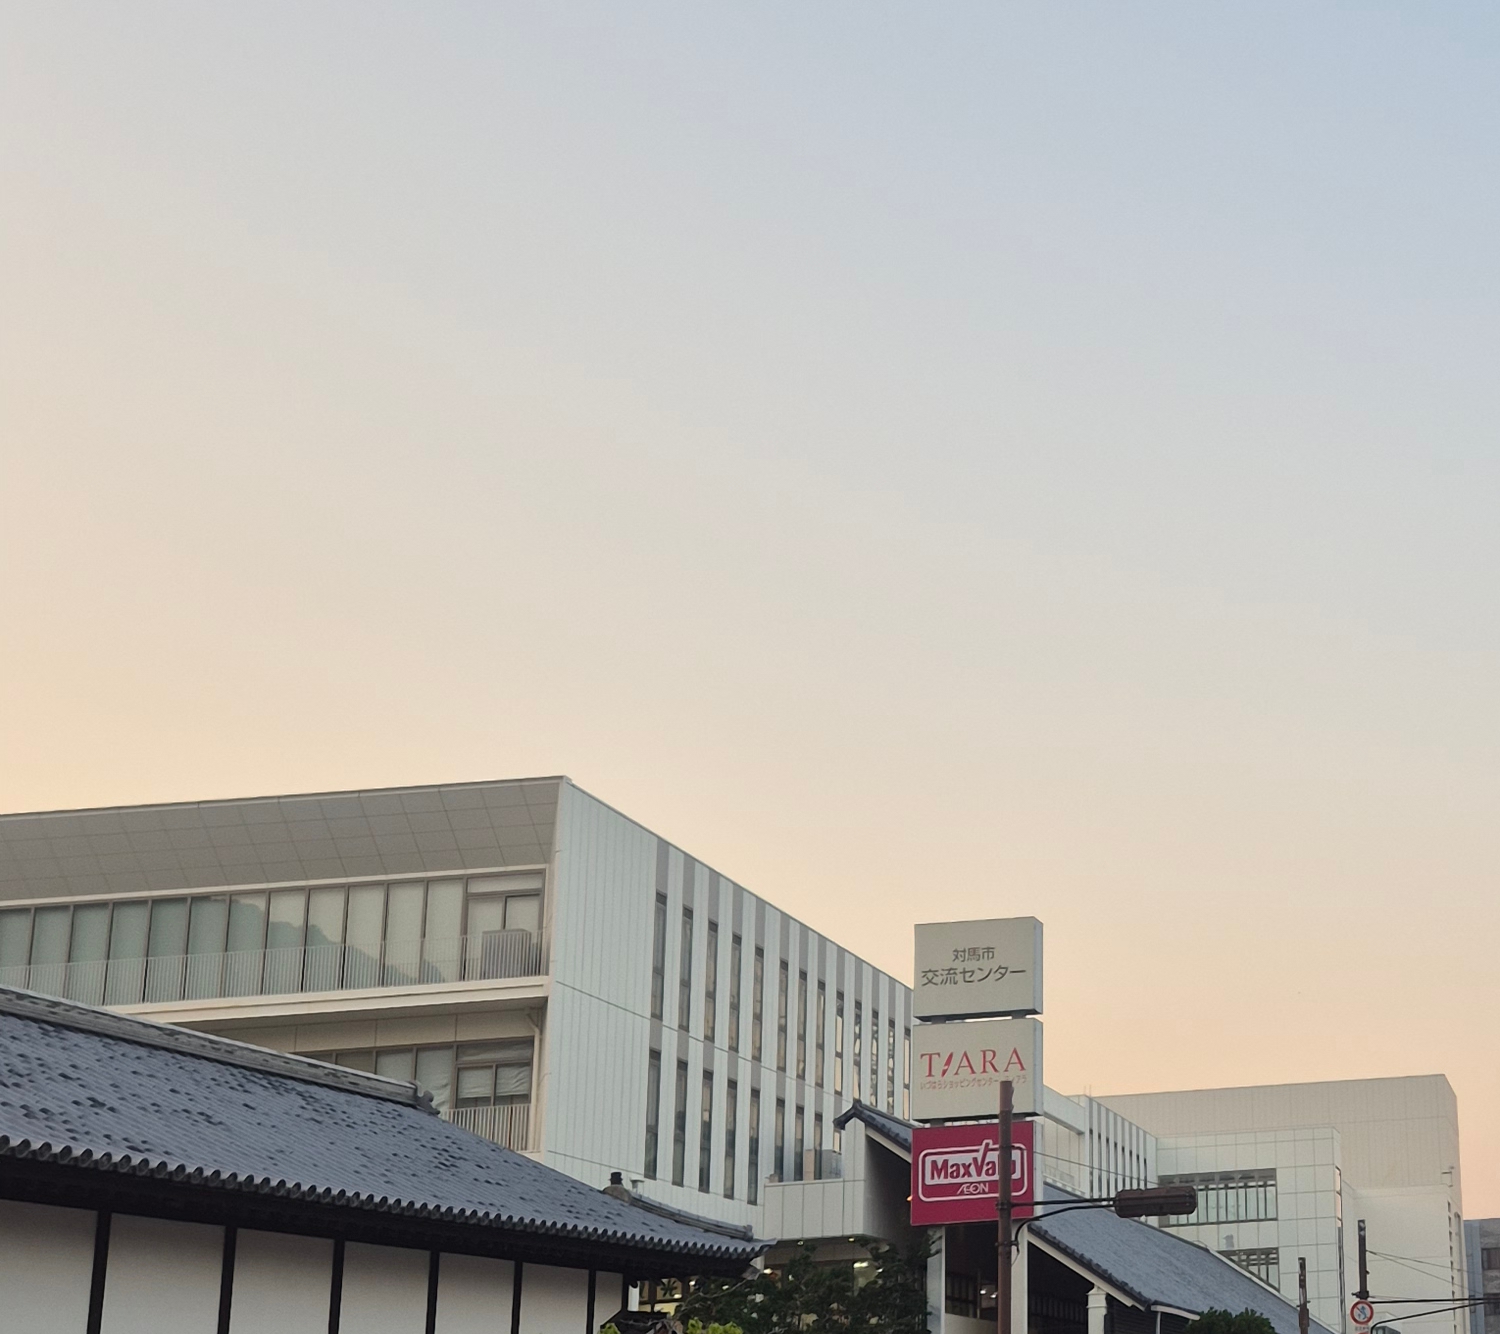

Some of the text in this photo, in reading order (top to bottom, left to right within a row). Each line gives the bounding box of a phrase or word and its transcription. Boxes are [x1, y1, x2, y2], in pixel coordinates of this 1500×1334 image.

[952, 946, 996, 963] 対馬市
[921, 965, 1027, 987] 交流センター
